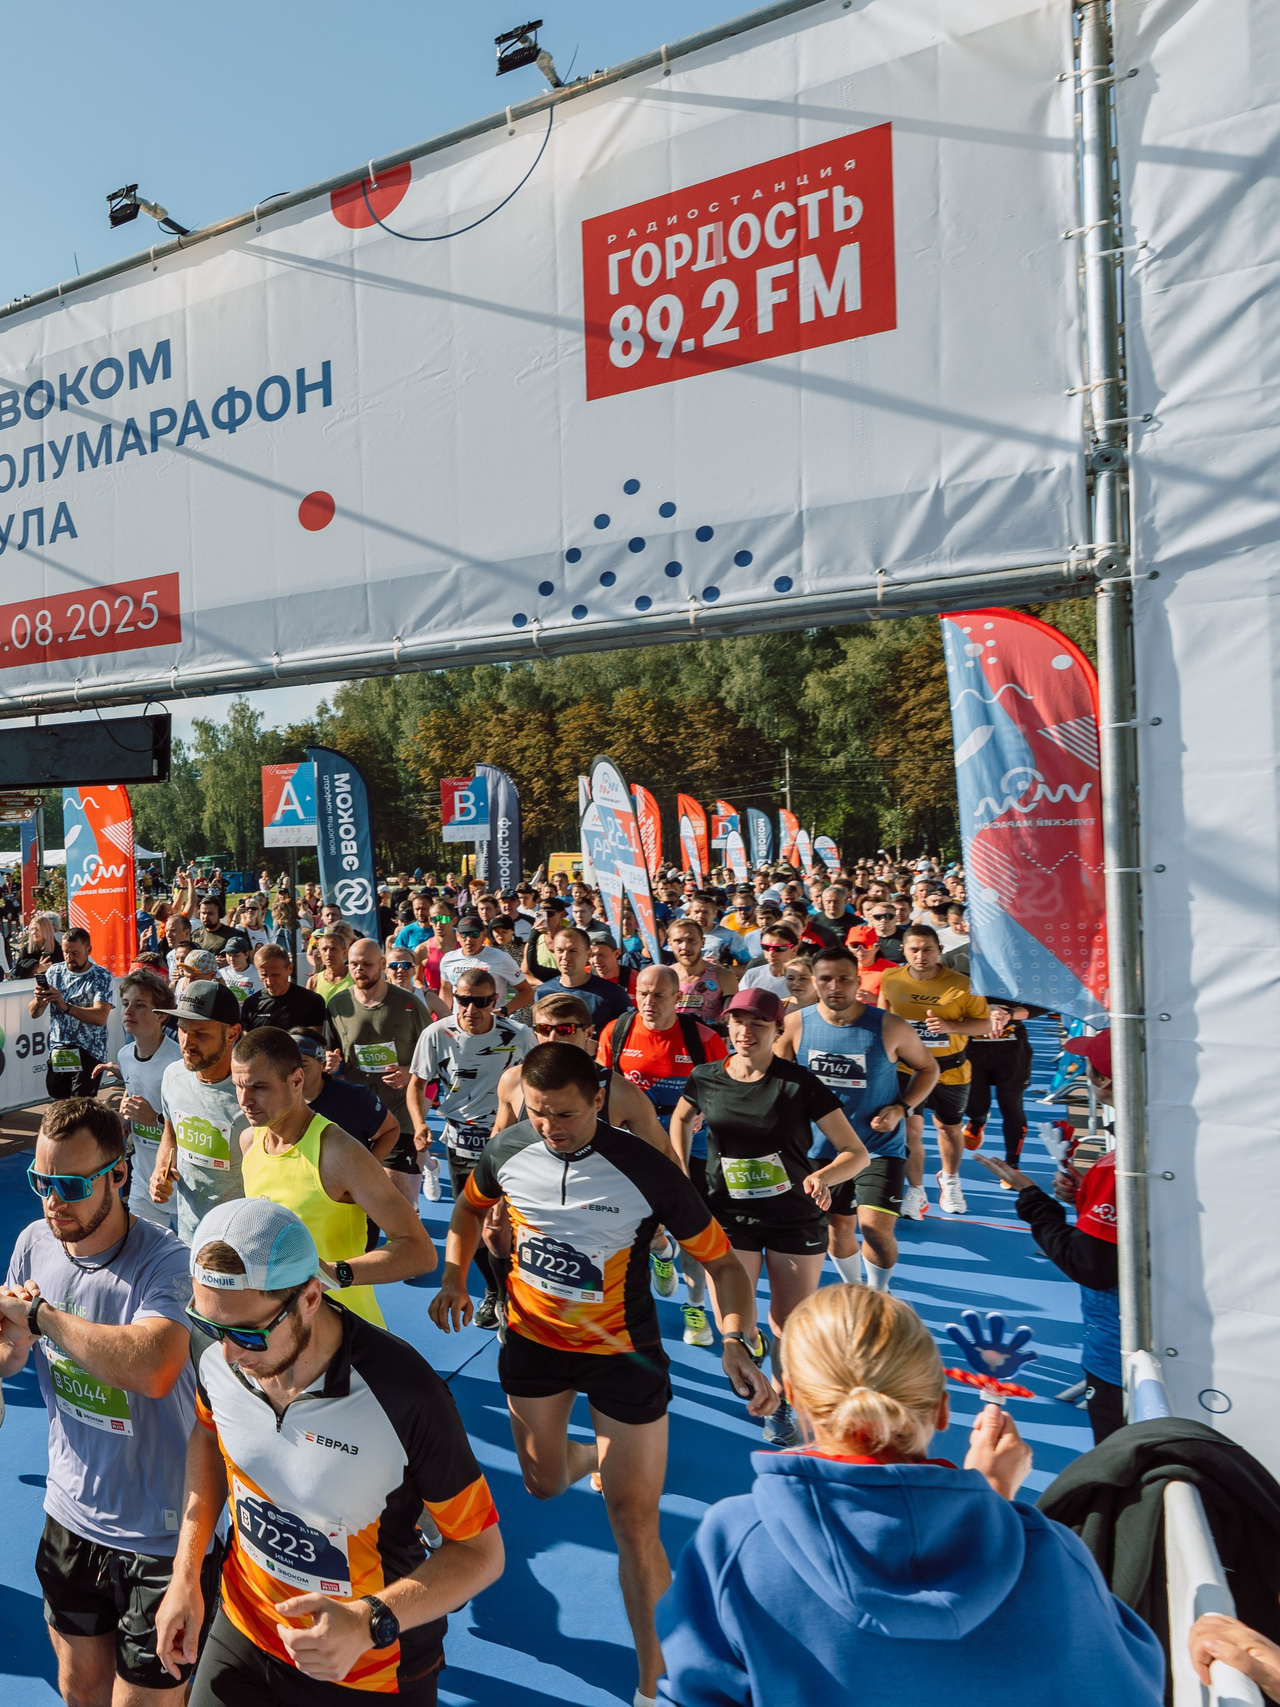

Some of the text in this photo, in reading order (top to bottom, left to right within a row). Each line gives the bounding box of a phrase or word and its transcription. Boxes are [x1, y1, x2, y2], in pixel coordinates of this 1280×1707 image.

[607, 158, 857, 244] РАДИОСТАНЦИЯ
[607, 185, 864, 296] ГОРДОСТЬ
[608, 241, 862, 369] 89.2 FM
[274, 781, 306, 820] A
[453, 791, 477, 821] B
[365, 1053, 387, 1062] 5106
[820, 1061, 851, 1074] 7147
[187, 1129, 213, 1149] 5191
[738, 1169, 770, 1183] 5144
[588, 1204, 620, 1214] ЕВРАЗ
[534, 1249, 581, 1279] 7222
[63, 1374, 107, 1404] 5044
[316, 1434, 359, 1456] ЕВРАЗ
[242, 1511, 317, 1563] B 7223
[275, 1552, 294, 1566] ИВАН
[277, 1568, 310, 1584] ЭВОКОМ
